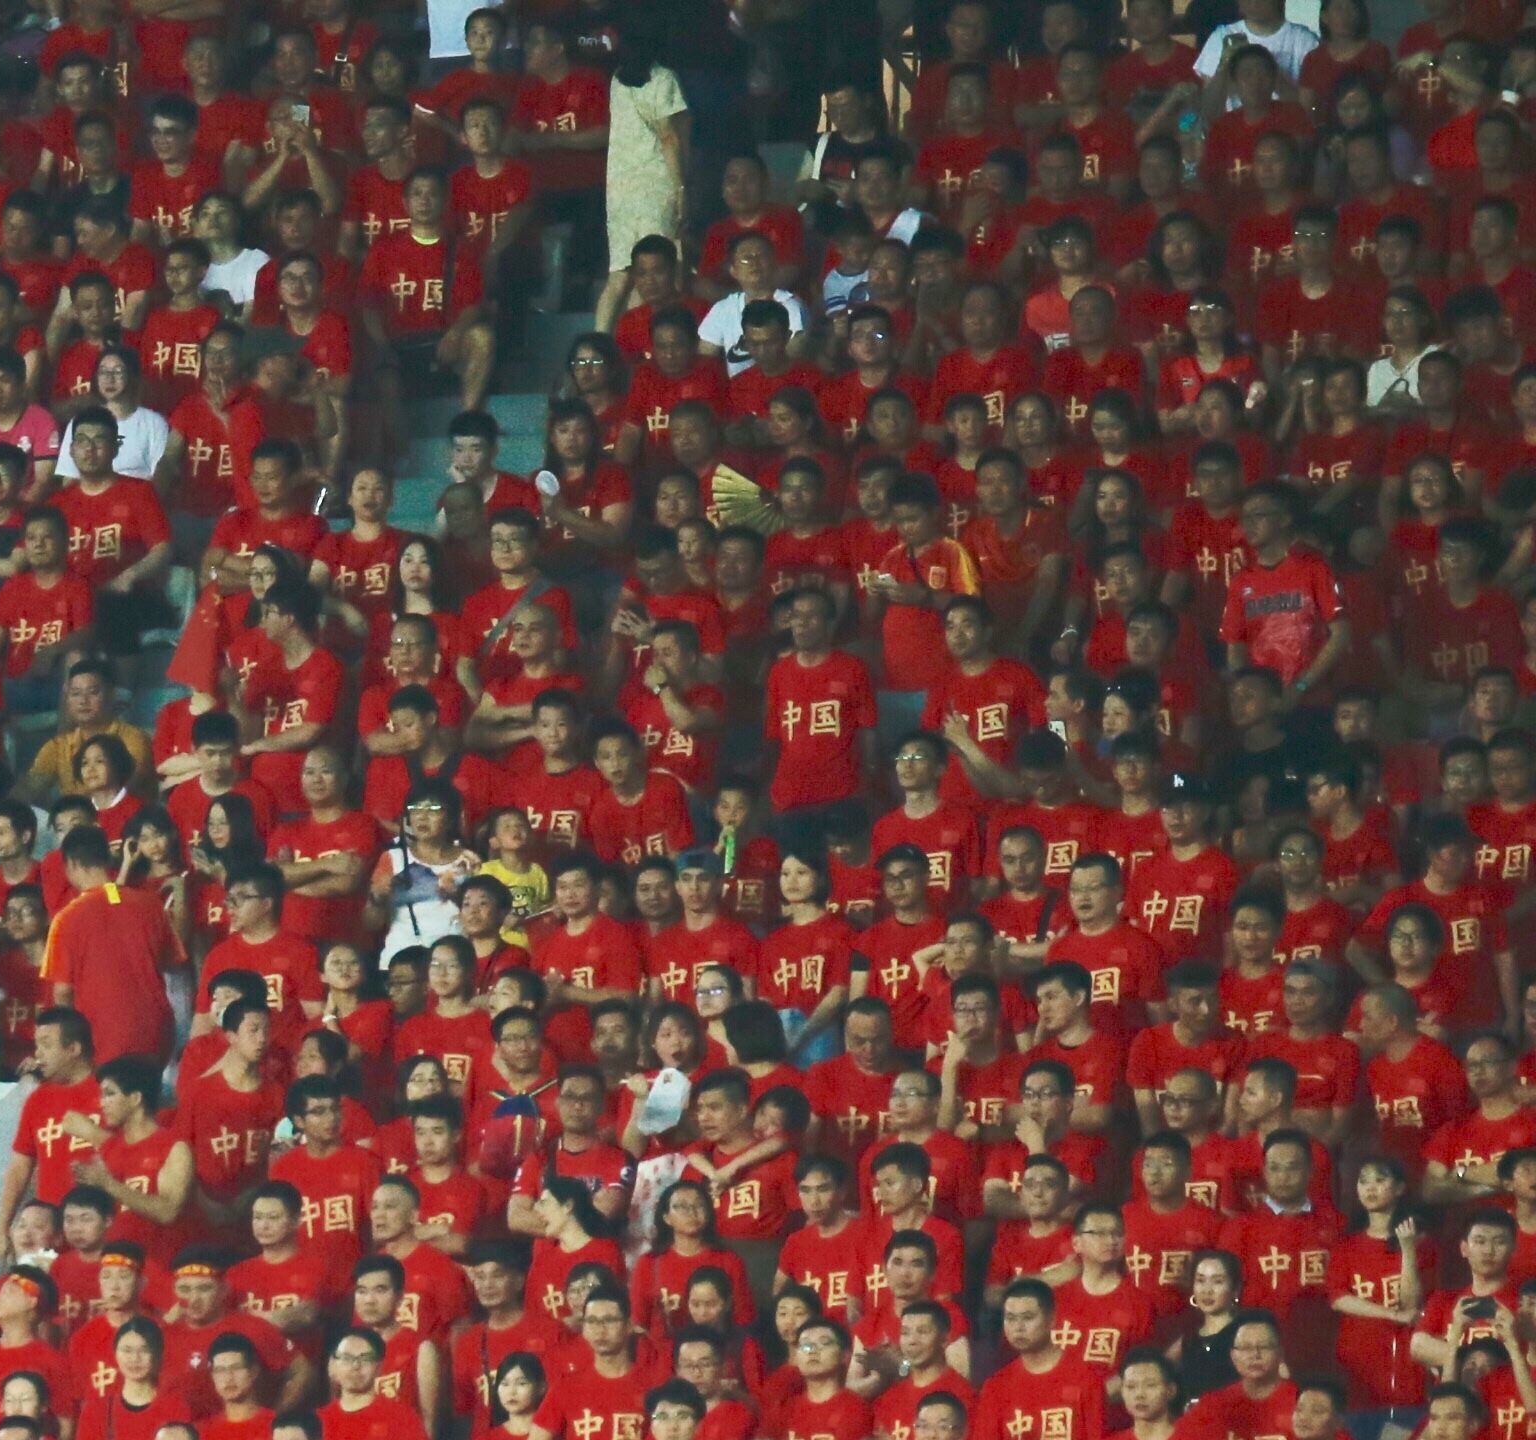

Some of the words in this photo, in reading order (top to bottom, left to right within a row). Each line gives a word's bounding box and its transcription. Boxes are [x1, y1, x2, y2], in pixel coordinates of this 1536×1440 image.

[154, 342, 200, 379] 中国
[70, 524, 121, 559] 中国
[336, 562, 390, 596] 中国
[782, 700, 840, 741] 中国
[643, 726, 693, 756] 中国
[1477, 845, 1531, 879] 中国
[1144, 890, 1204, 934] 中国
[301, 1196, 352, 1232] 中国
[1127, 1248, 1191, 1285] 中国
[1259, 1248, 1327, 1285] 中国
[1052, 1321, 1120, 1364] 中国
